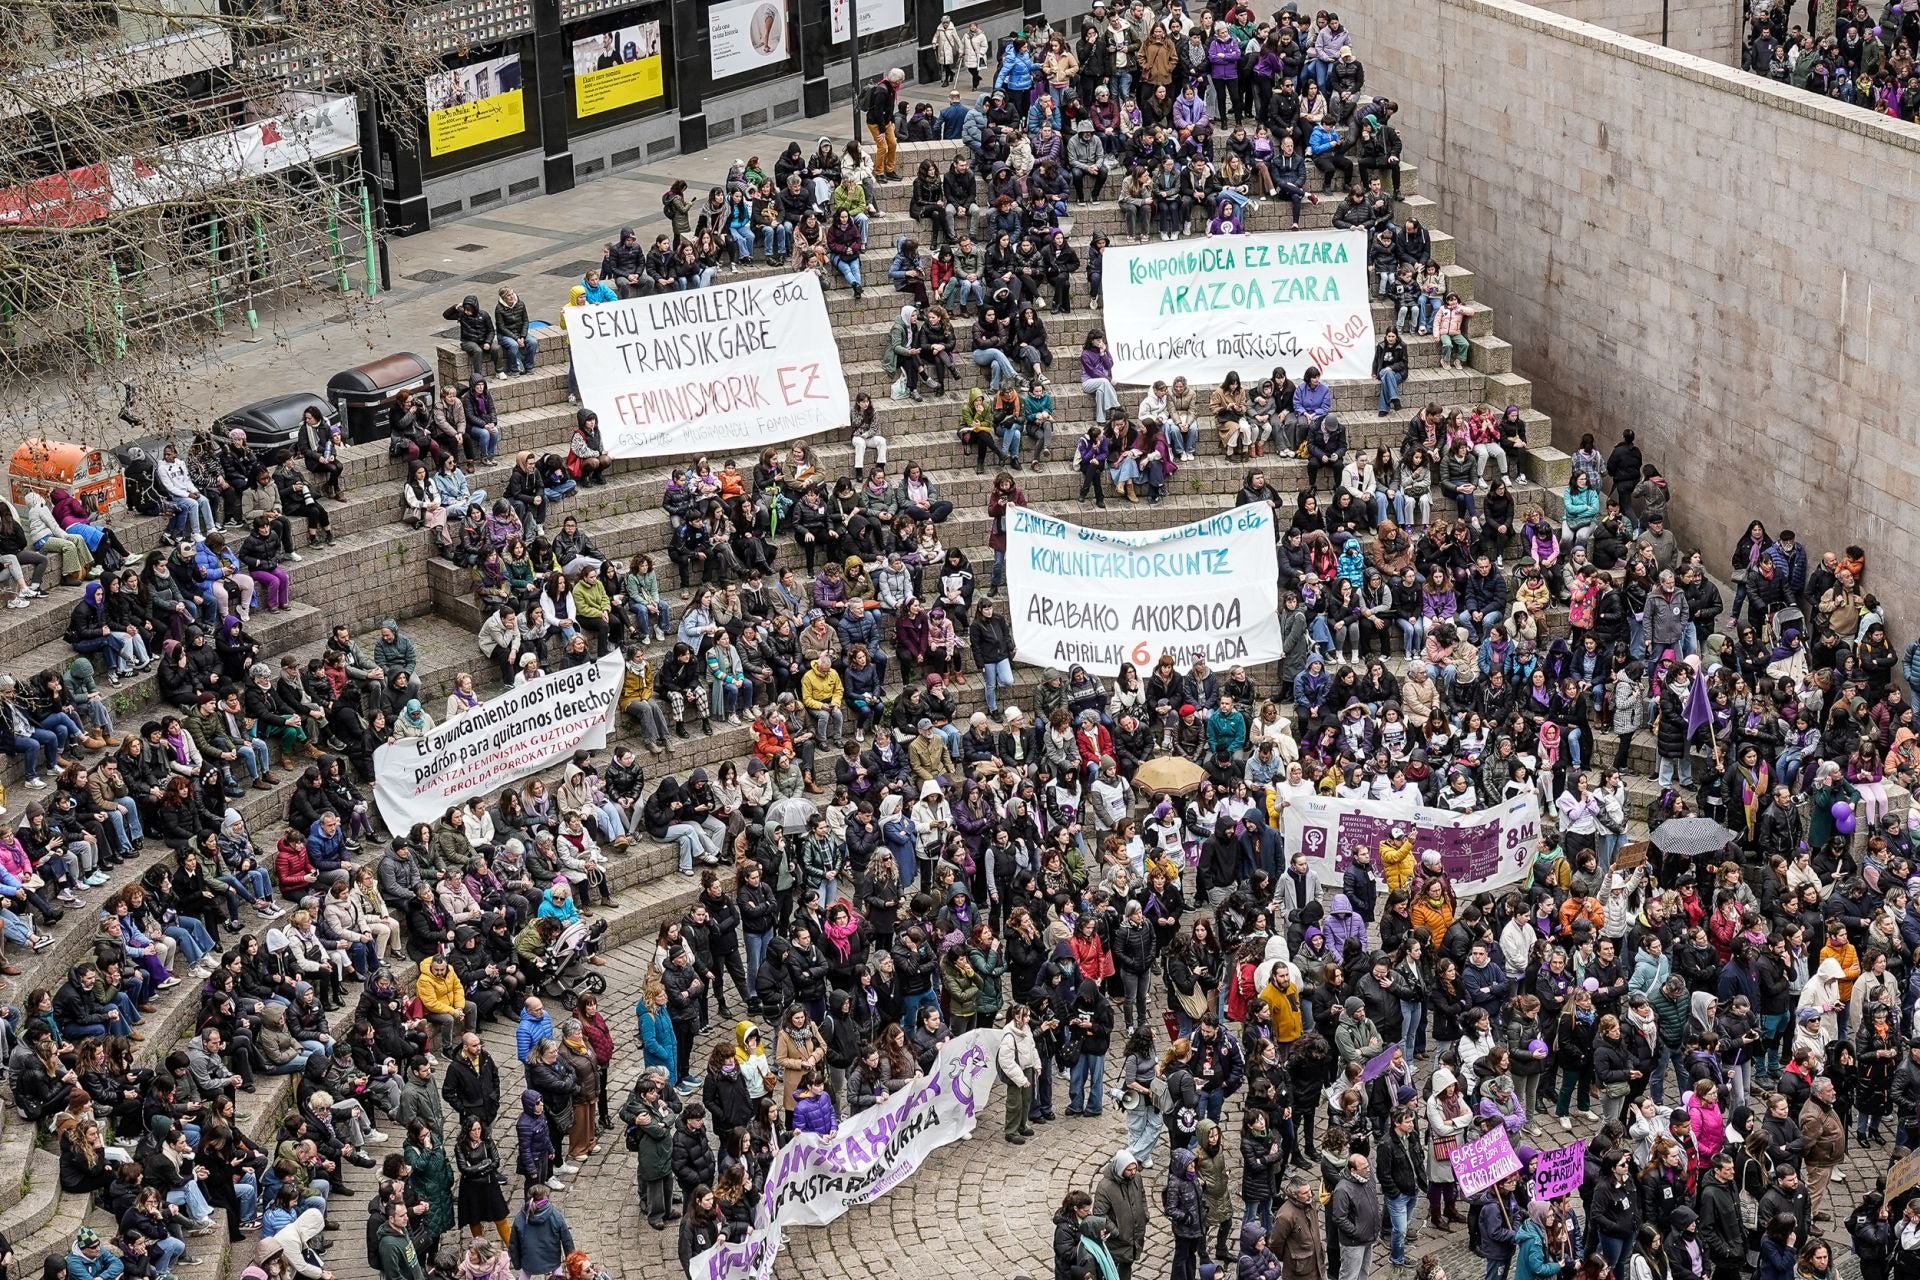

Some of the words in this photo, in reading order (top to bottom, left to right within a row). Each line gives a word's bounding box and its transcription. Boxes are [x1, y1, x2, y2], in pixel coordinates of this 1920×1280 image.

[1129, 248, 1235, 285] KONPONBIDEA
[1245, 246, 1271, 268] EZ
[1278, 242, 1348, 266] BAZARA
[582, 309, 638, 339] SEXU
[649, 285, 766, 331] LANGILERIK
[773, 281, 808, 306] eta
[1159, 277, 1265, 316] ARAZOA
[1272, 276, 1341, 305] ZARA
[1217, 331, 1303, 360] matxista
[615, 374, 770, 426] FEMINISMORIK
[777, 363, 830, 407] EZ
[1013, 511, 1067, 540] ZAINTZA
[1237, 510, 1269, 532] eta
[1027, 593, 1119, 632] ARABAKO
[1131, 598, 1241, 633] AKORDIOA
[1131, 641, 1151, 666] 6
[416, 739, 433, 757] El
[434, 701, 518, 752] ayuntamiento
[521, 686, 545, 709] nos
[545, 673, 584, 698] niega
[587, 663, 602, 683] el
[415, 751, 457, 784] padrón
[460, 739, 490, 766] para
[493, 711, 552, 750] quitarnos
[555, 686, 616, 722] derechos
[468, 739, 528, 777] FEMINISTAK
[443, 768, 492, 797] ERROLDA
[1506, 821, 1534, 850] 8M
[883, 1105, 941, 1169] AURKA
[1451, 1143, 1477, 1164] GURE
[1470, 1154, 1485, 1169] EZ
